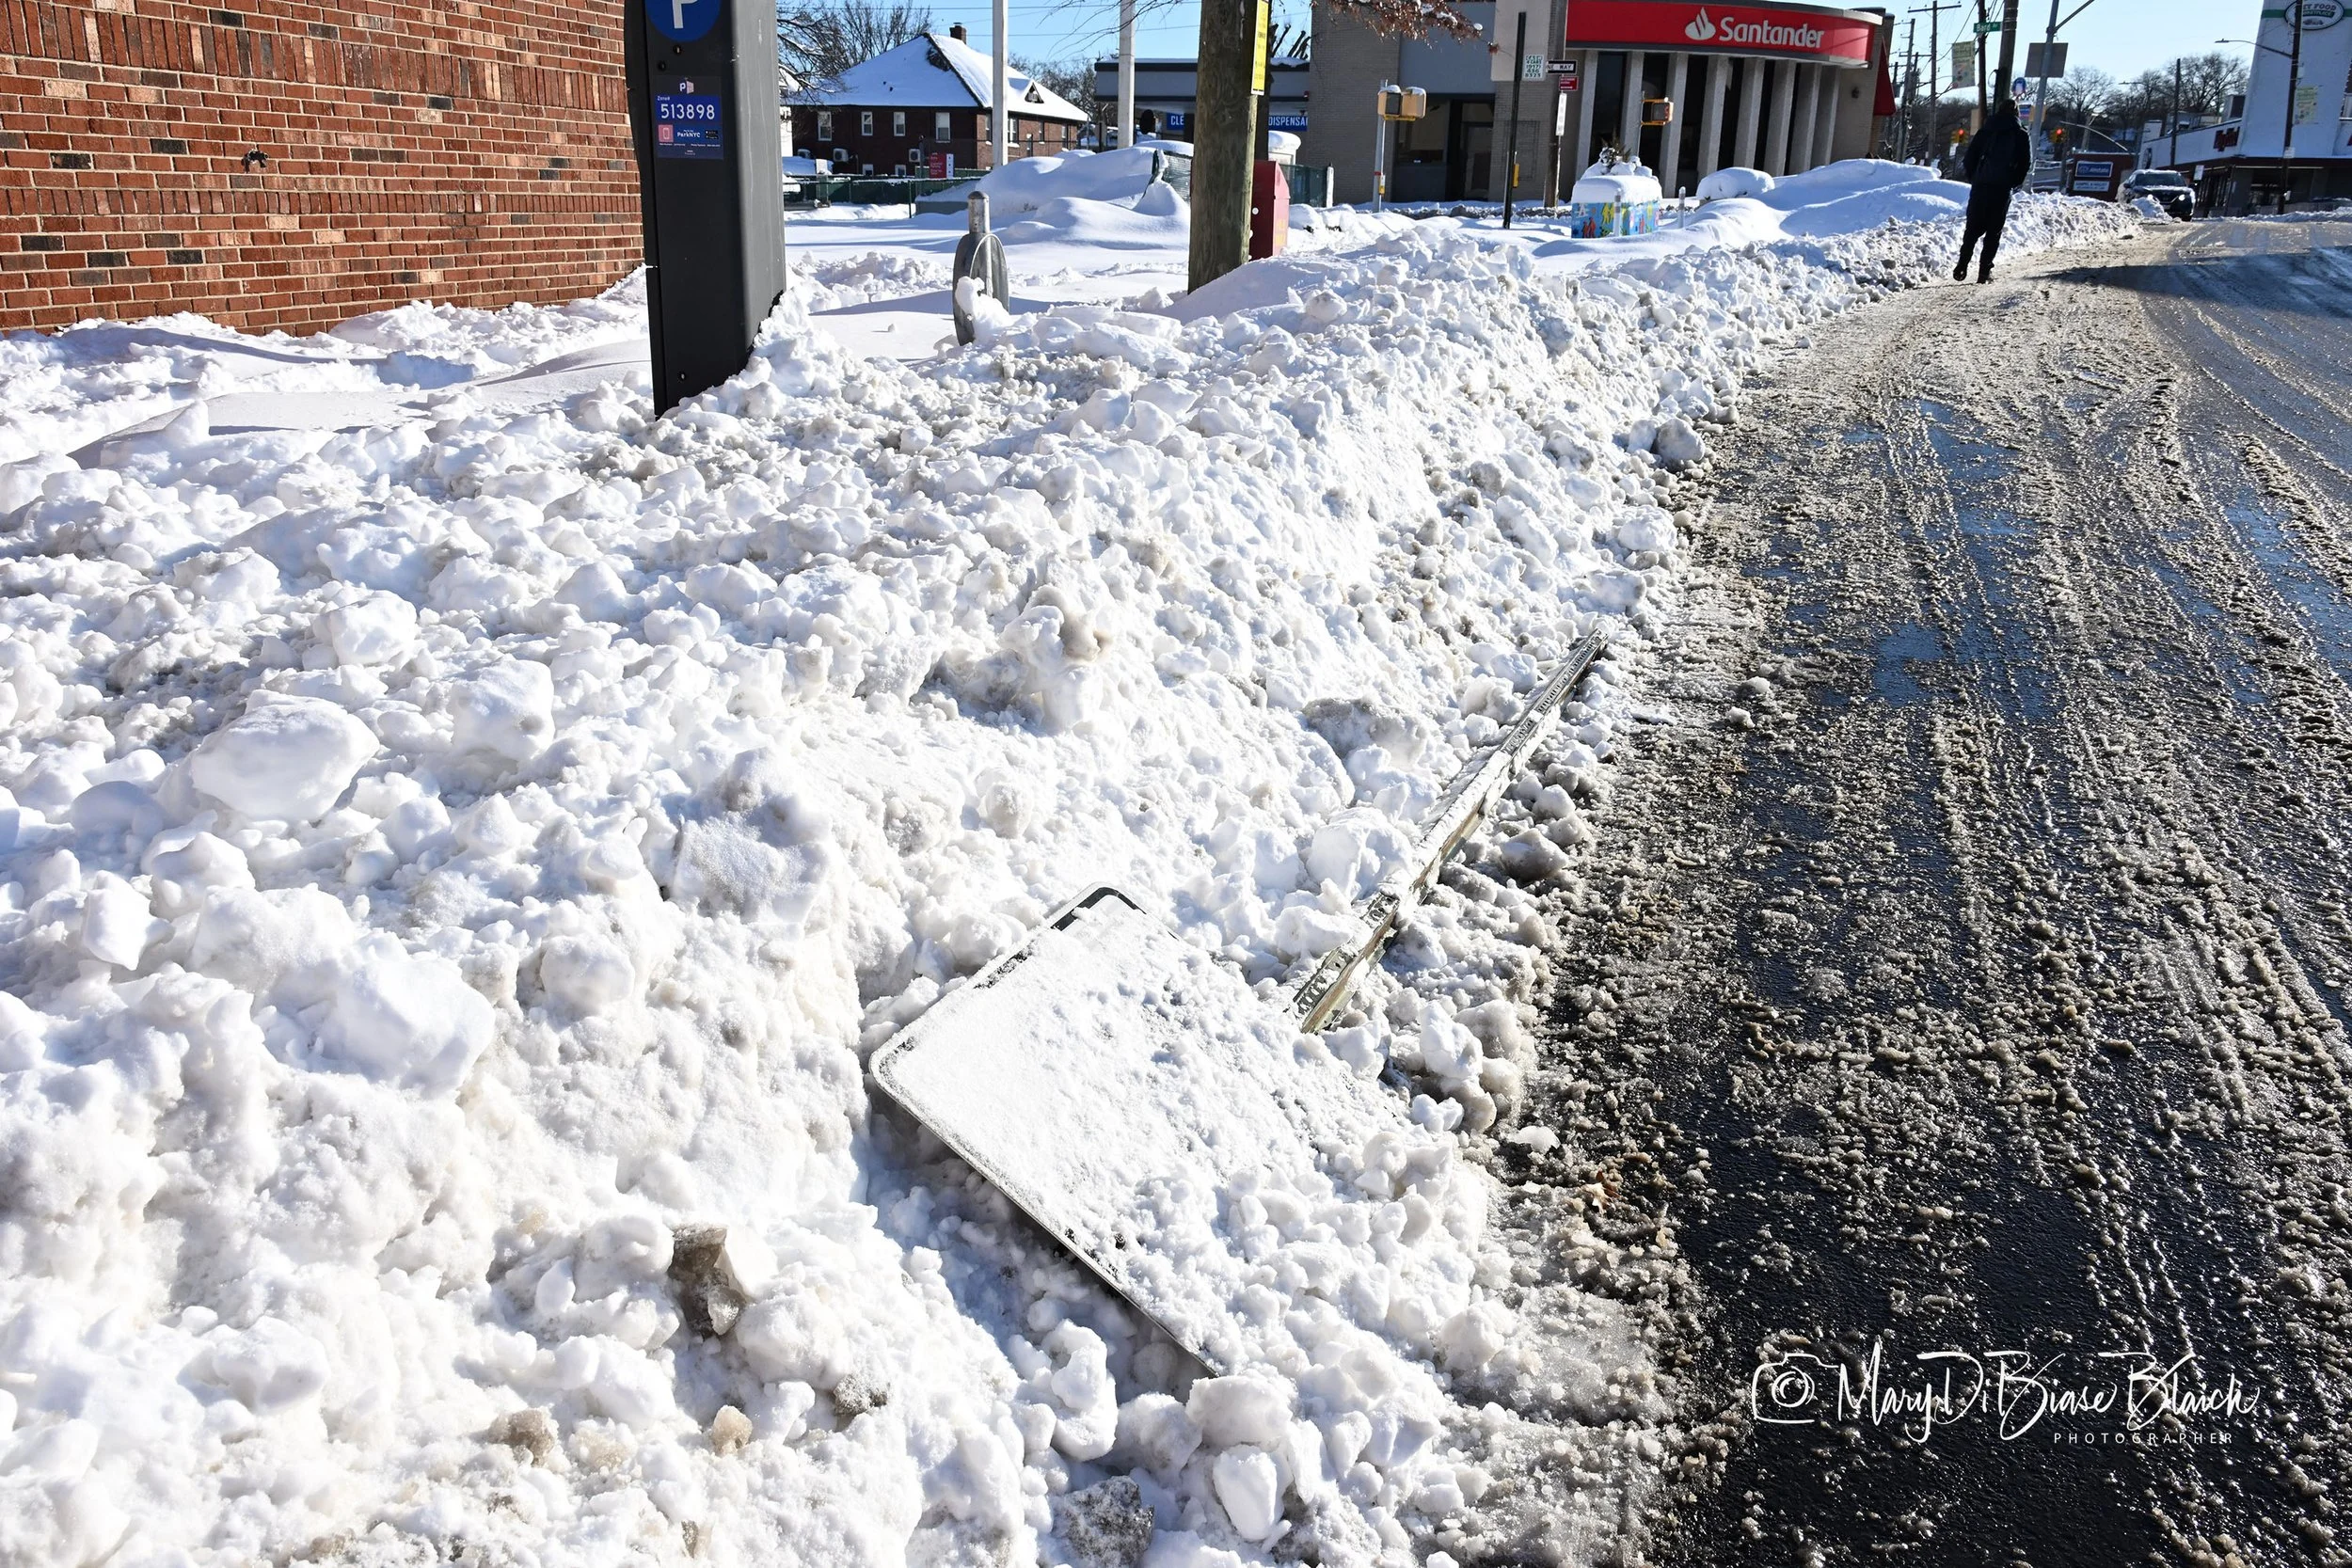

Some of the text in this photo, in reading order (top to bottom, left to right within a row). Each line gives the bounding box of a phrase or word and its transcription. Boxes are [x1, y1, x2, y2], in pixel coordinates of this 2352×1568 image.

[1719, 17, 1824, 48] Santander
[1977, 23, 1990, 31] Bard
[660, 103, 715, 119] 513898
[1269, 116, 1308, 126] DISPENSA
